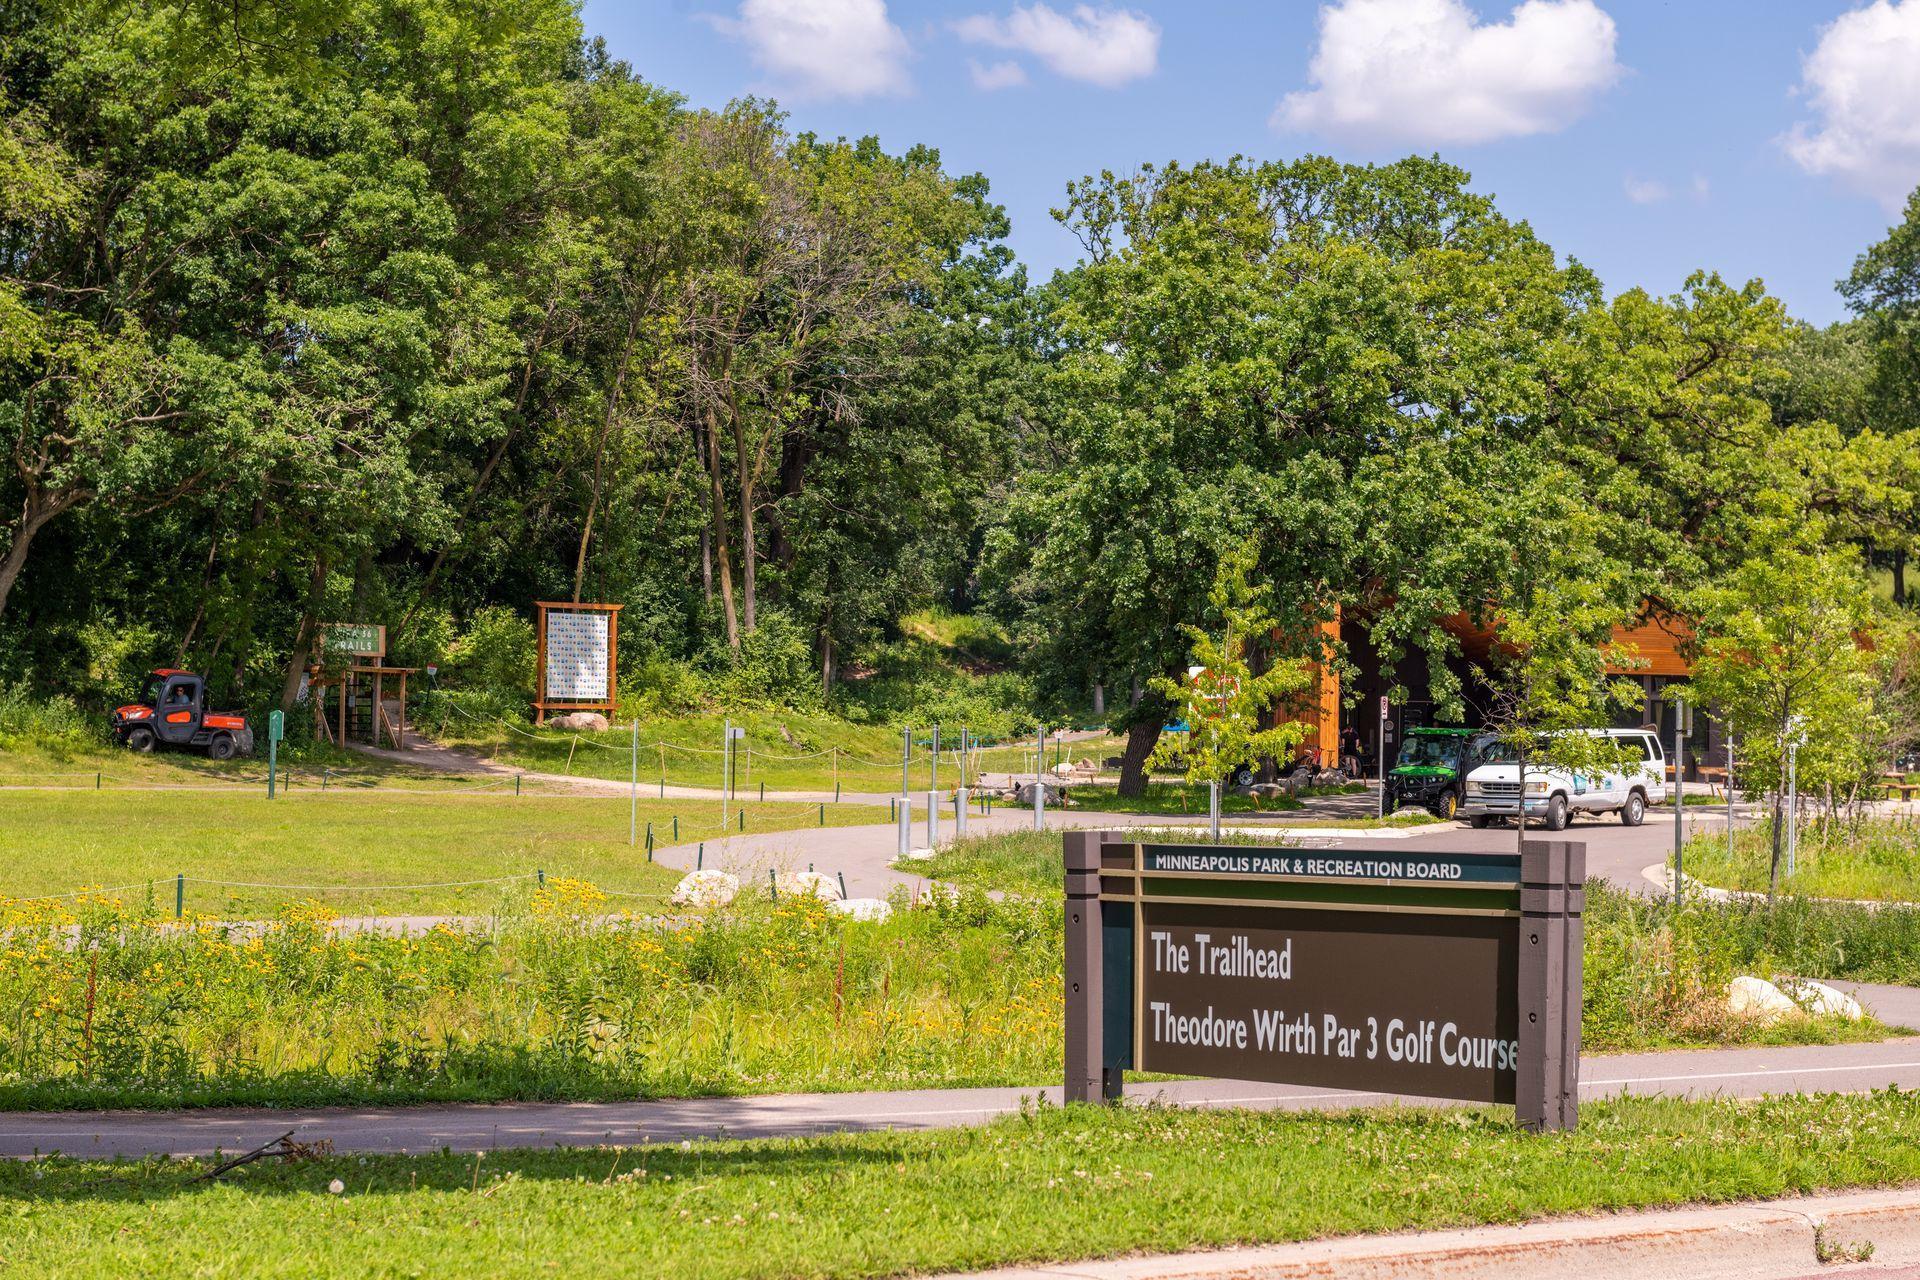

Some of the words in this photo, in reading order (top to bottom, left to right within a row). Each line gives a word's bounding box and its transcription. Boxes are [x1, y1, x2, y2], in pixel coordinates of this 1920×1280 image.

[335, 641, 372, 651] RAILS
[1155, 854, 1249, 872] MINNEAPOLIS
[1252, 858, 1290, 873] PARK
[1293, 858, 1304, 874] &
[1307, 859, 1403, 877] RECREATION
[1406, 862, 1462, 879] BOARD
[1150, 931, 1190, 974] The
[1194, 933, 1292, 980] Trailhead
[1150, 1001, 1248, 1049] Theodore
[1252, 1008, 1316, 1055] Wirth
[1323, 1013, 1361, 1058] Par
[1366, 1016, 1378, 1060] 3
[1386, 1018, 1435, 1064] Golf
[1439, 1021, 1519, 1072] Course
